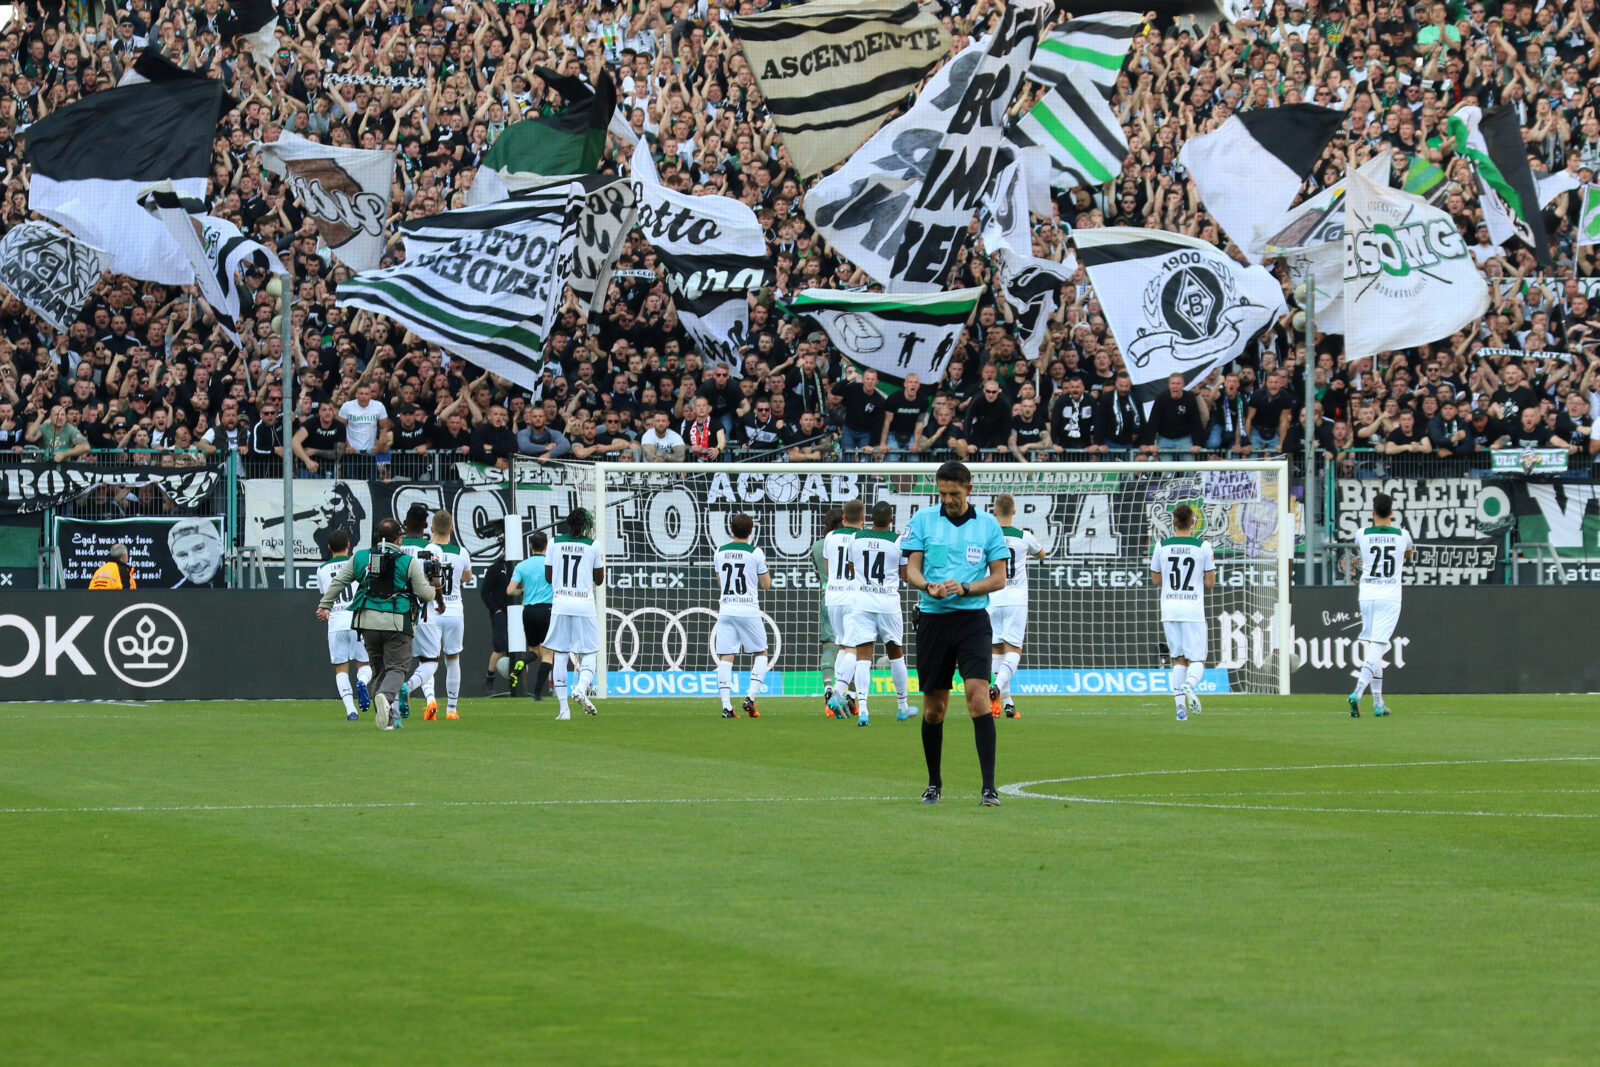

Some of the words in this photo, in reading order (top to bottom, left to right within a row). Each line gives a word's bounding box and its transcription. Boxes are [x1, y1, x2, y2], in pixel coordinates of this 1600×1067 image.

[761, 27, 941, 80] ASCENDENTE
[1162, 251, 1200, 272] 1900
[72, 532, 97, 547] Egal
[99, 536, 116, 545] was
[118, 535, 134, 545] wir
[261, 537, 303, 549] rabake
[96, 548, 110, 556] wo
[1369, 546, 1396, 578] 25
[68, 558, 79, 567] in
[81, 560, 106, 568] unser
[81, 567, 93, 579] du
[562, 554, 583, 588] 17
[862, 550, 886, 586] 14
[607, 567, 685, 588] latex
[721, 562, 748, 596] 23
[771, 566, 820, 588] ate
[1050, 566, 1144, 587] flatex
[1167, 556, 1196, 592] 32
[1214, 566, 1297, 587] late
[1215, 609, 1411, 679] Biburgr
[1019, 683, 1062, 694] www.
[1065, 672, 1179, 693] JONGE
